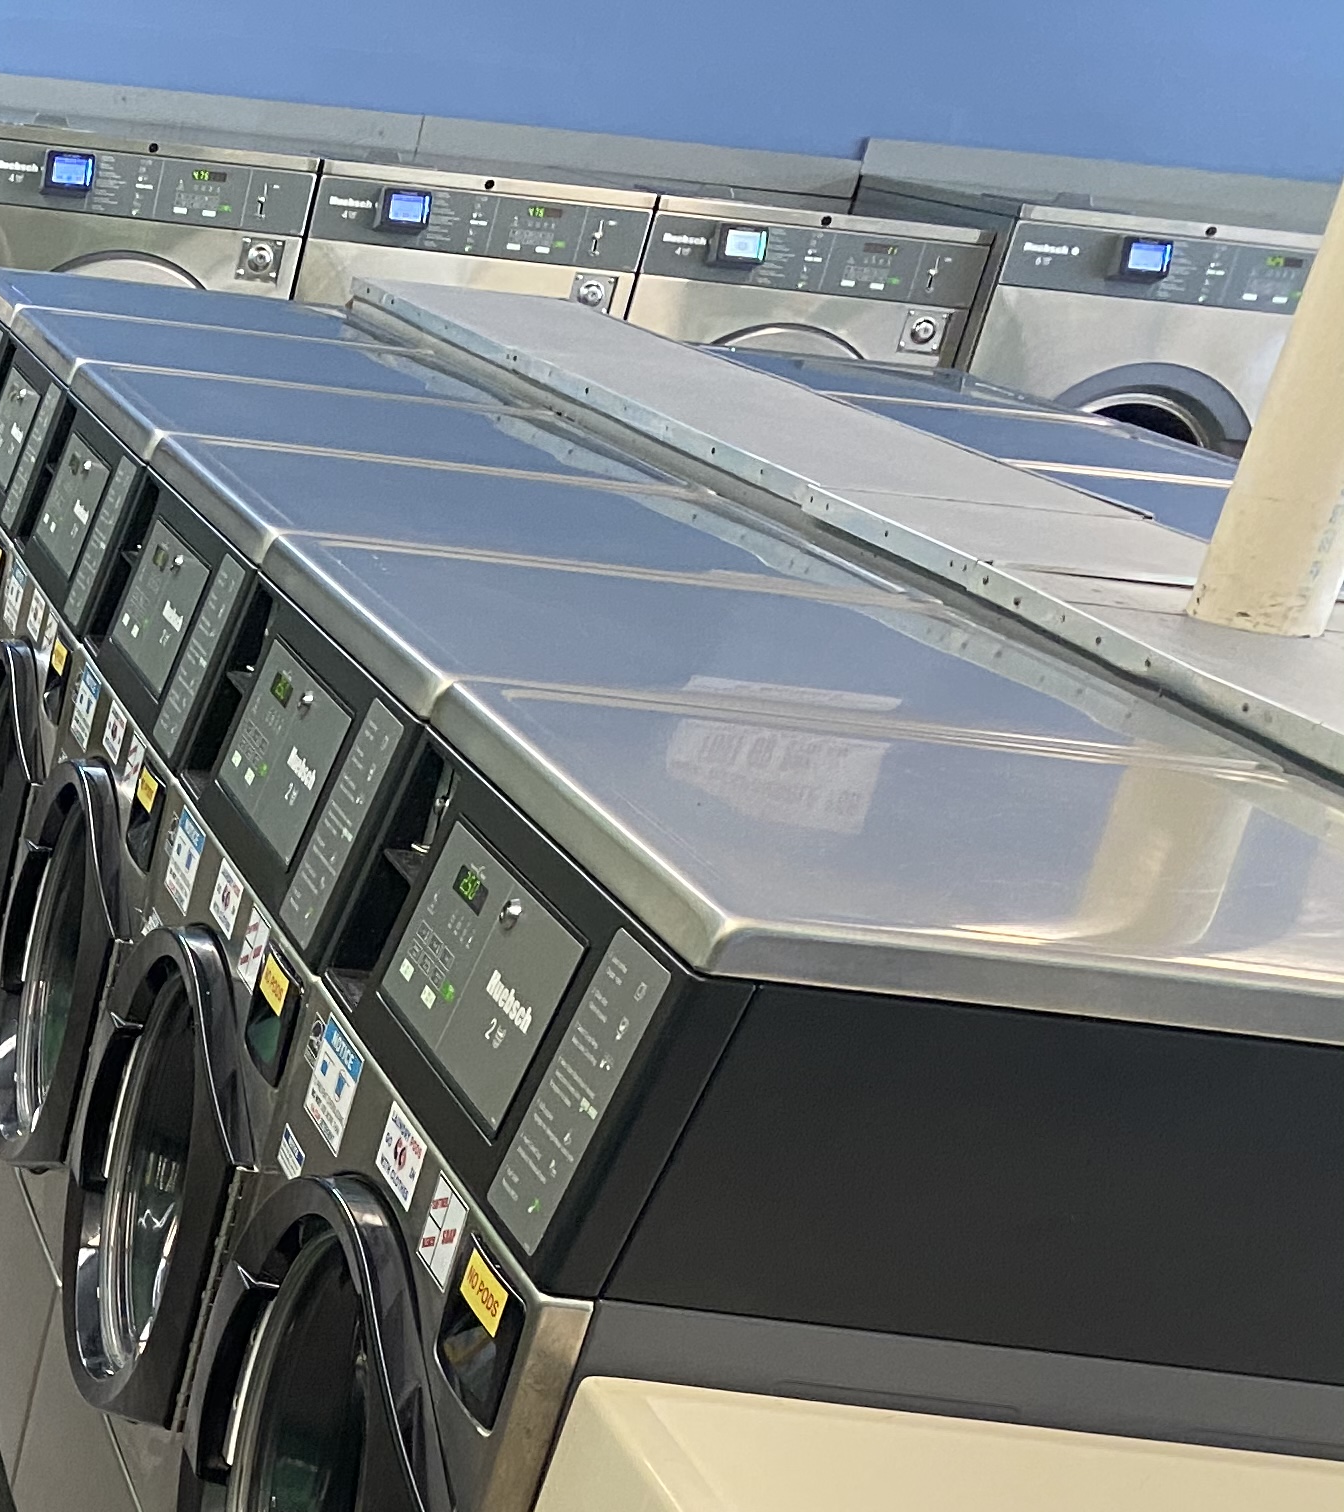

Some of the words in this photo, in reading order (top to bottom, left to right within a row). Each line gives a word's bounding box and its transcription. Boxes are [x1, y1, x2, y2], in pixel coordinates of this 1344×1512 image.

[485, 969, 533, 1035] Huebsch
[331, 1029, 356, 1071] NOTICE
[484, 1017, 498, 1040] 2
[467, 1264, 479, 1290] NO
[476, 1280, 500, 1318] PODS
